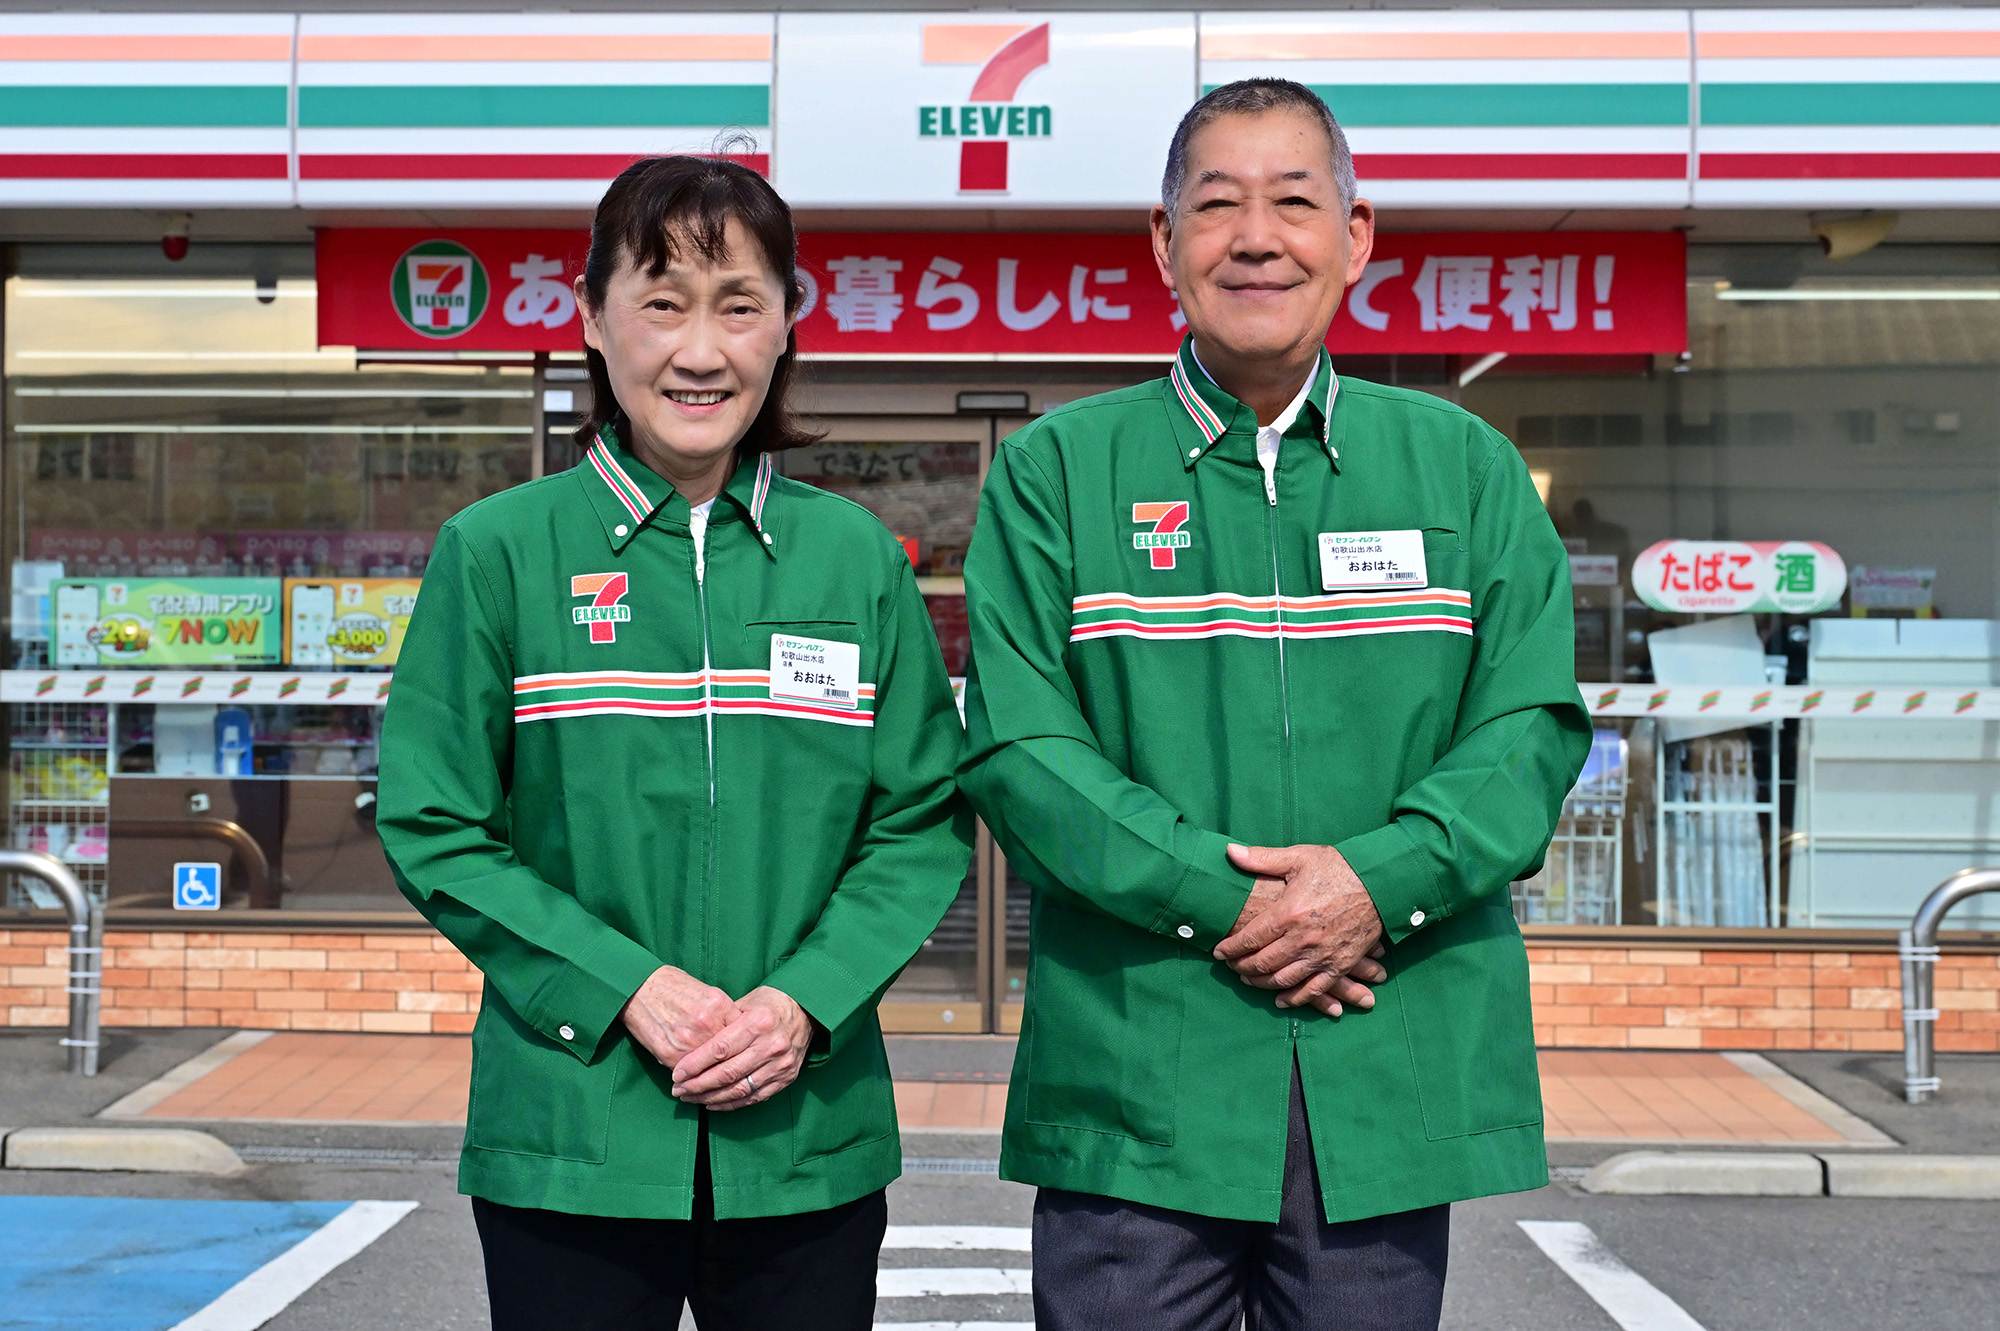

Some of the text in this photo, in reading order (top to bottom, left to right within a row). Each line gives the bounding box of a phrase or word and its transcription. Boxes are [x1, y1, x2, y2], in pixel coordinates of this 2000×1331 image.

[1348, 560, 1398, 572] おおはた
[1660, 551, 1755, 592] たばこ
[1775, 552, 1816, 593] 酒
[162, 618, 259, 645] 7NOW
[793, 670, 836, 687] おおはた
